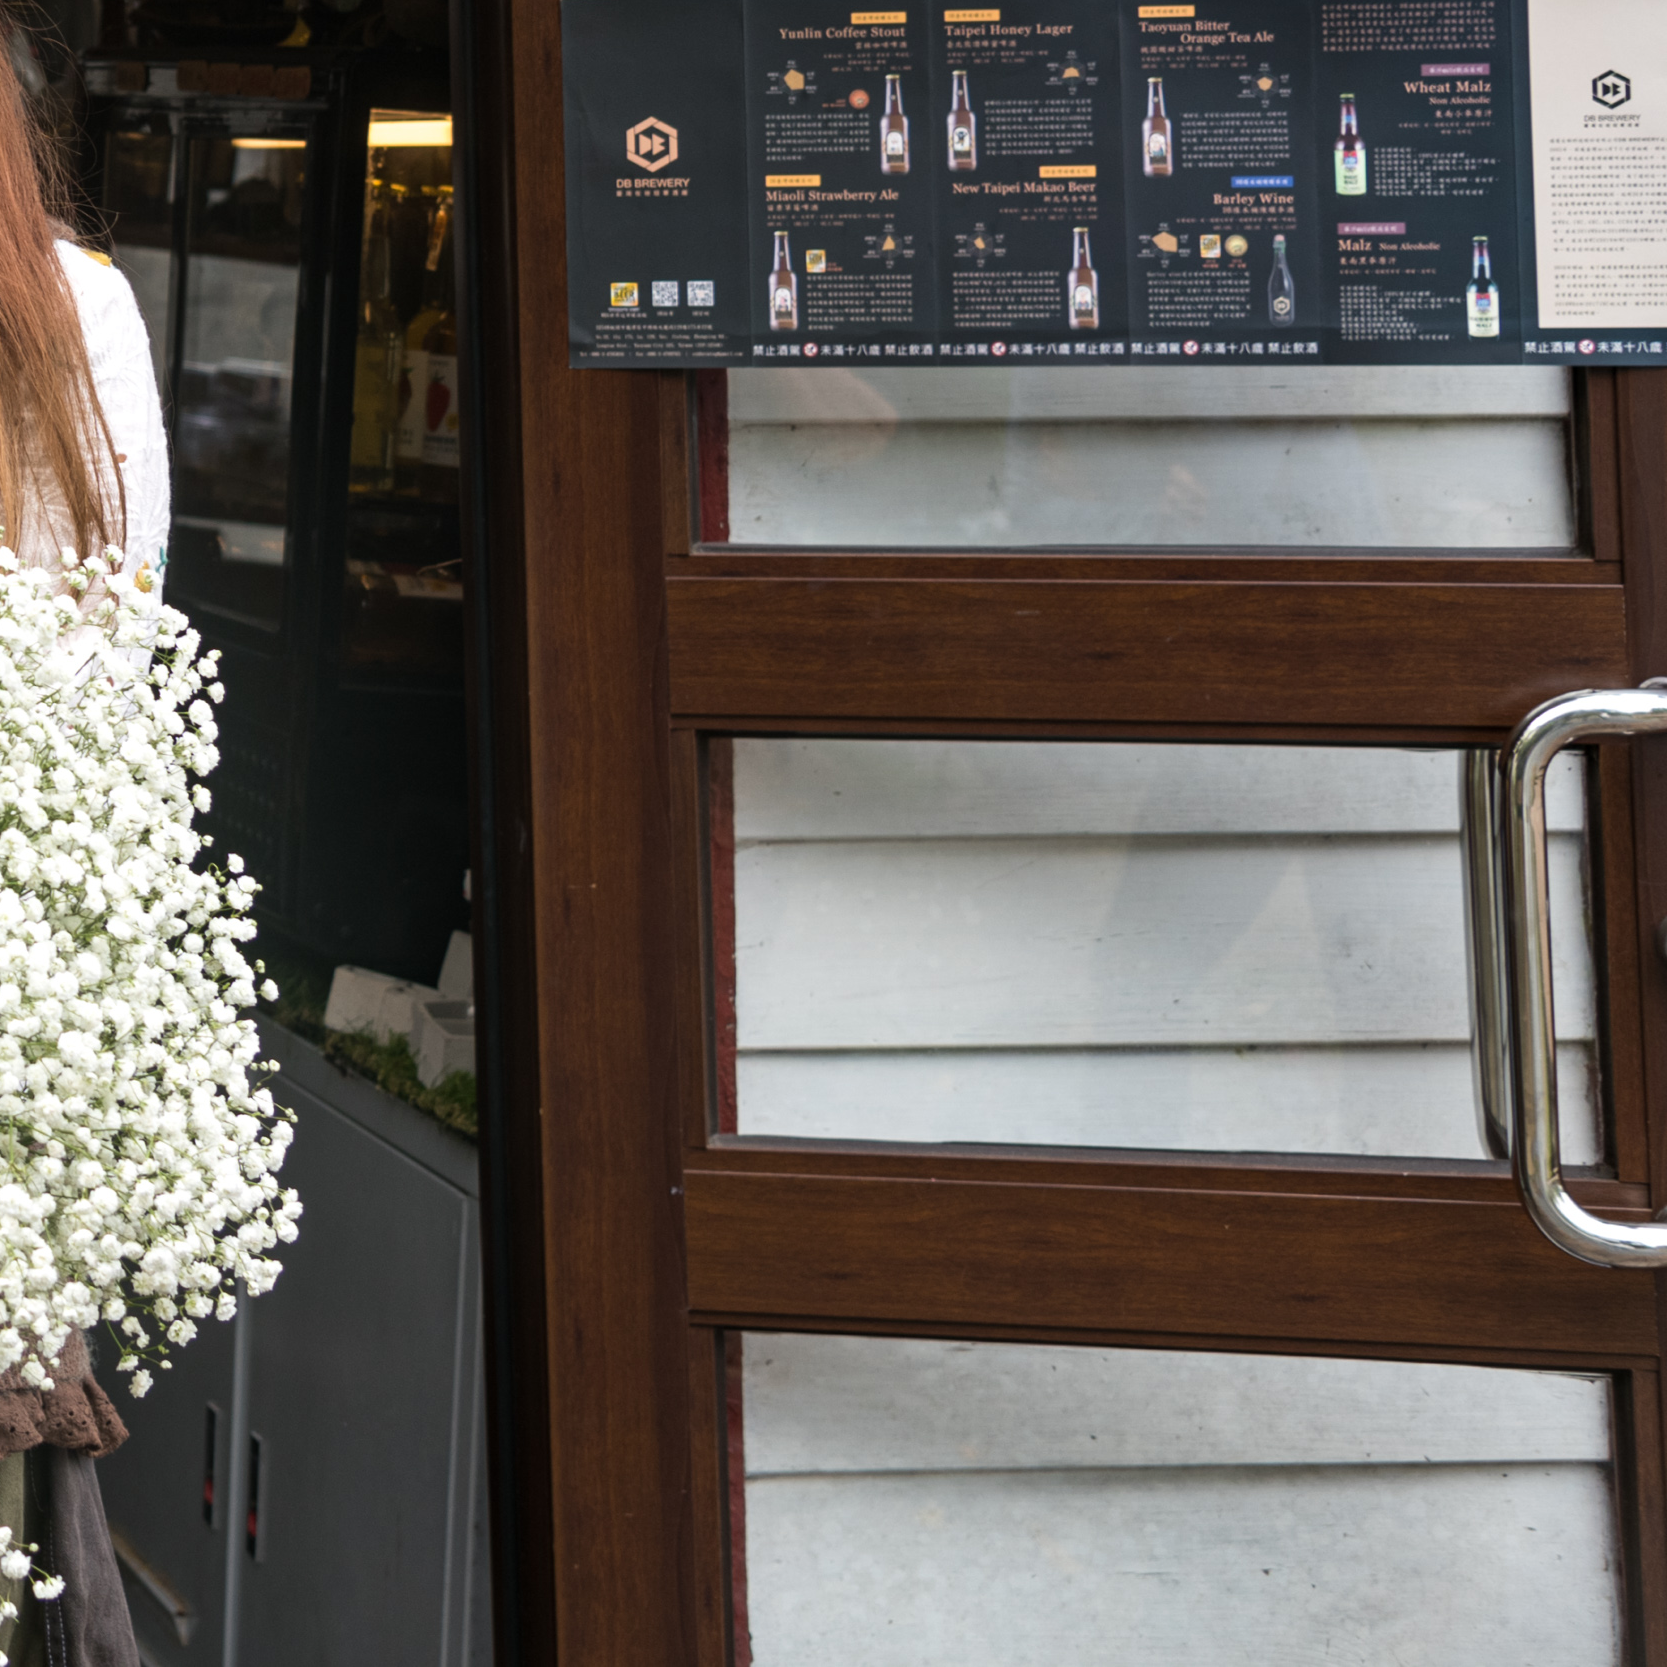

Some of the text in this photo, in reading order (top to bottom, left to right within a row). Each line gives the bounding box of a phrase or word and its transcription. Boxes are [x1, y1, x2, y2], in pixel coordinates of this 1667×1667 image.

[779, 25, 906, 40] Yunlin Coffee Stout
[944, 23, 1073, 38] Taipei Honey Lager
[1138, 20, 1231, 34] Taoyuan Bitter
[1180, 31, 1275, 45] Orange Tea Ale
[1403, 80, 1492, 94] Wheat Malz
[1429, 96, 1491, 105] Non Alcoholic
[1598, 114, 1641, 122] BREWERY
[616, 177, 690, 189] DB BREWERY
[953, 181, 1097, 196] New Taipei Makao Beer
[766, 189, 899, 203] Miaoli Strawberry Ale
[1213, 193, 1295, 206] Barley Wine
[1338, 238, 1441, 251] Malz Non Alcoholic
[753, 344, 801, 356] 禁止酒駕
[820, 343, 880, 356] 未滿十八歲
[885, 343, 933, 356] 禁止飲酒
[940, 342, 1124, 356] 禁止酒駕 未滿十八歲 禁止飲酒
[1131, 341, 1318, 355] 禁止酒駕 未滿十八歲 禁止飲酒
[1524, 341, 1662, 354] 禁止酒駕 未滿十八歲
